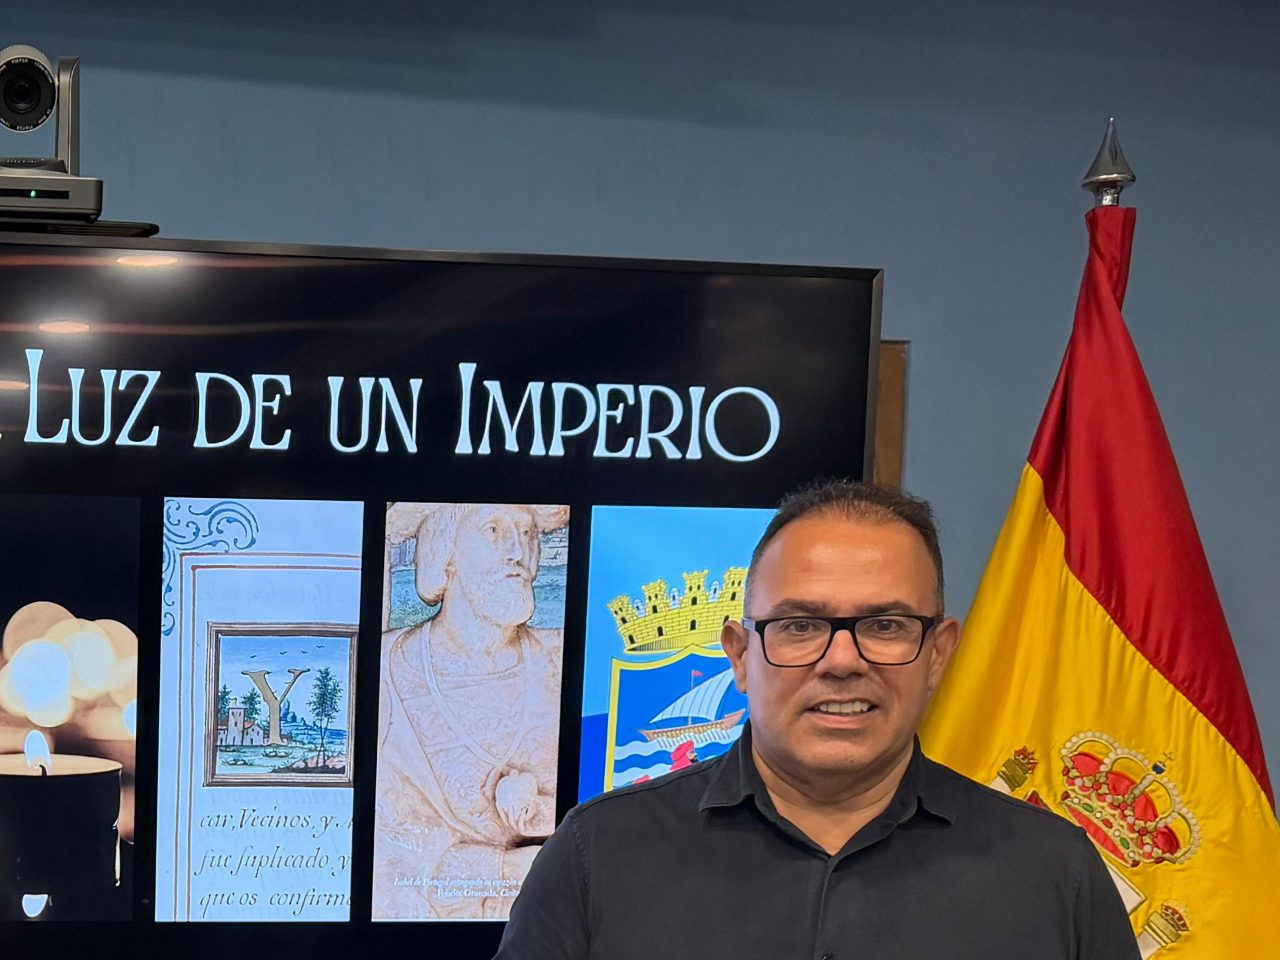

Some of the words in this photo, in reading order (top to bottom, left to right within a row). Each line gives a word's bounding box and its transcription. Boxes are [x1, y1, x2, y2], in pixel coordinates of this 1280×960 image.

[193, 372, 291, 450] DE
[328, 376, 423, 454] UN
[455, 362, 781, 462] IMPERIO
[241, 668, 311, 747] Y
